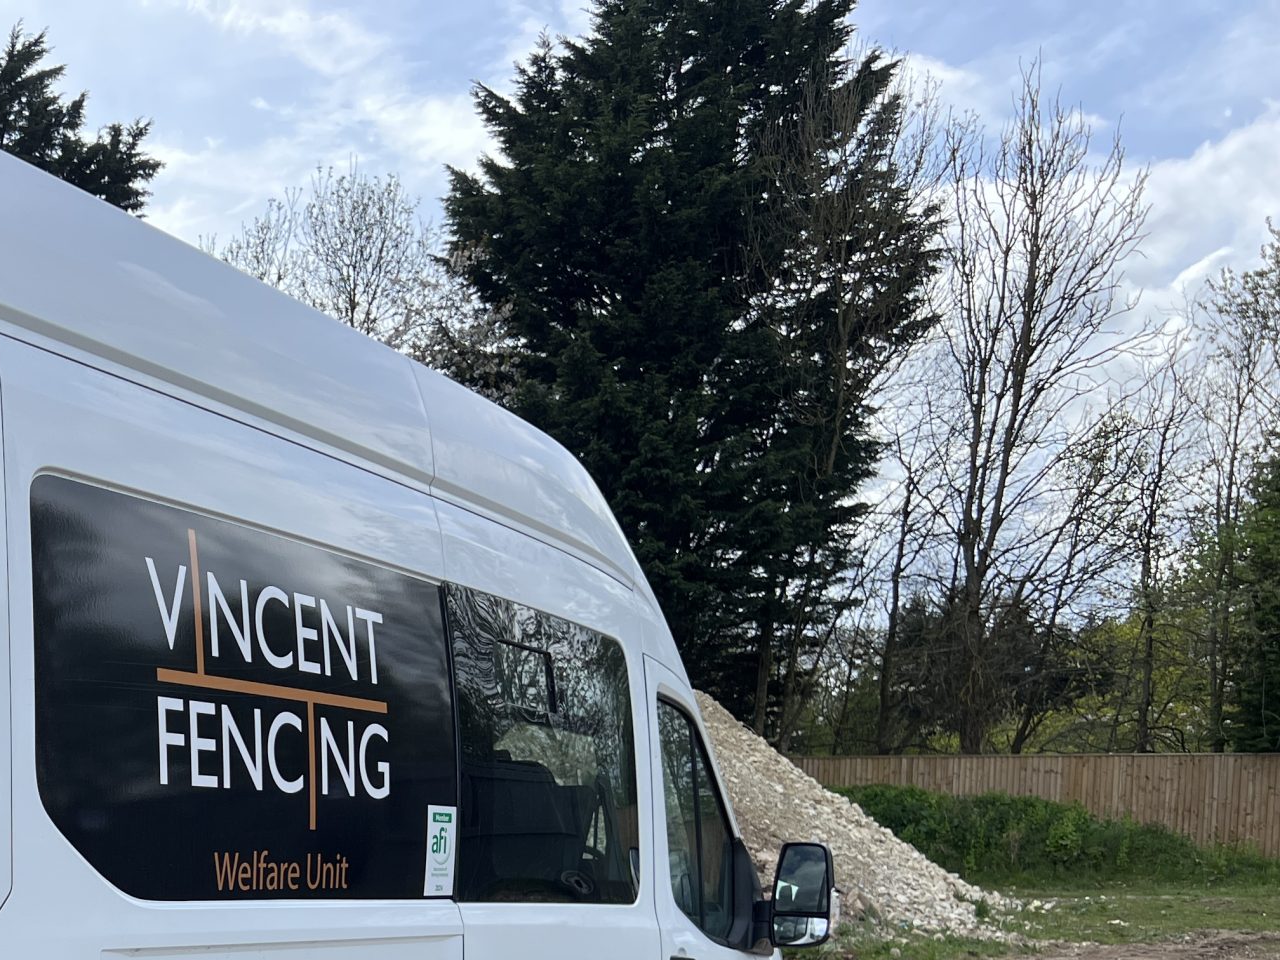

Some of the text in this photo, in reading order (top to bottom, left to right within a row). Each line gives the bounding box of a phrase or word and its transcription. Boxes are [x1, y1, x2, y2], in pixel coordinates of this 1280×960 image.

[145, 529, 383, 684] VINCENT
[157, 696, 391, 829] FENCING
[214, 850, 349, 891] Welfare Unit
[431, 826, 448, 854] afi
